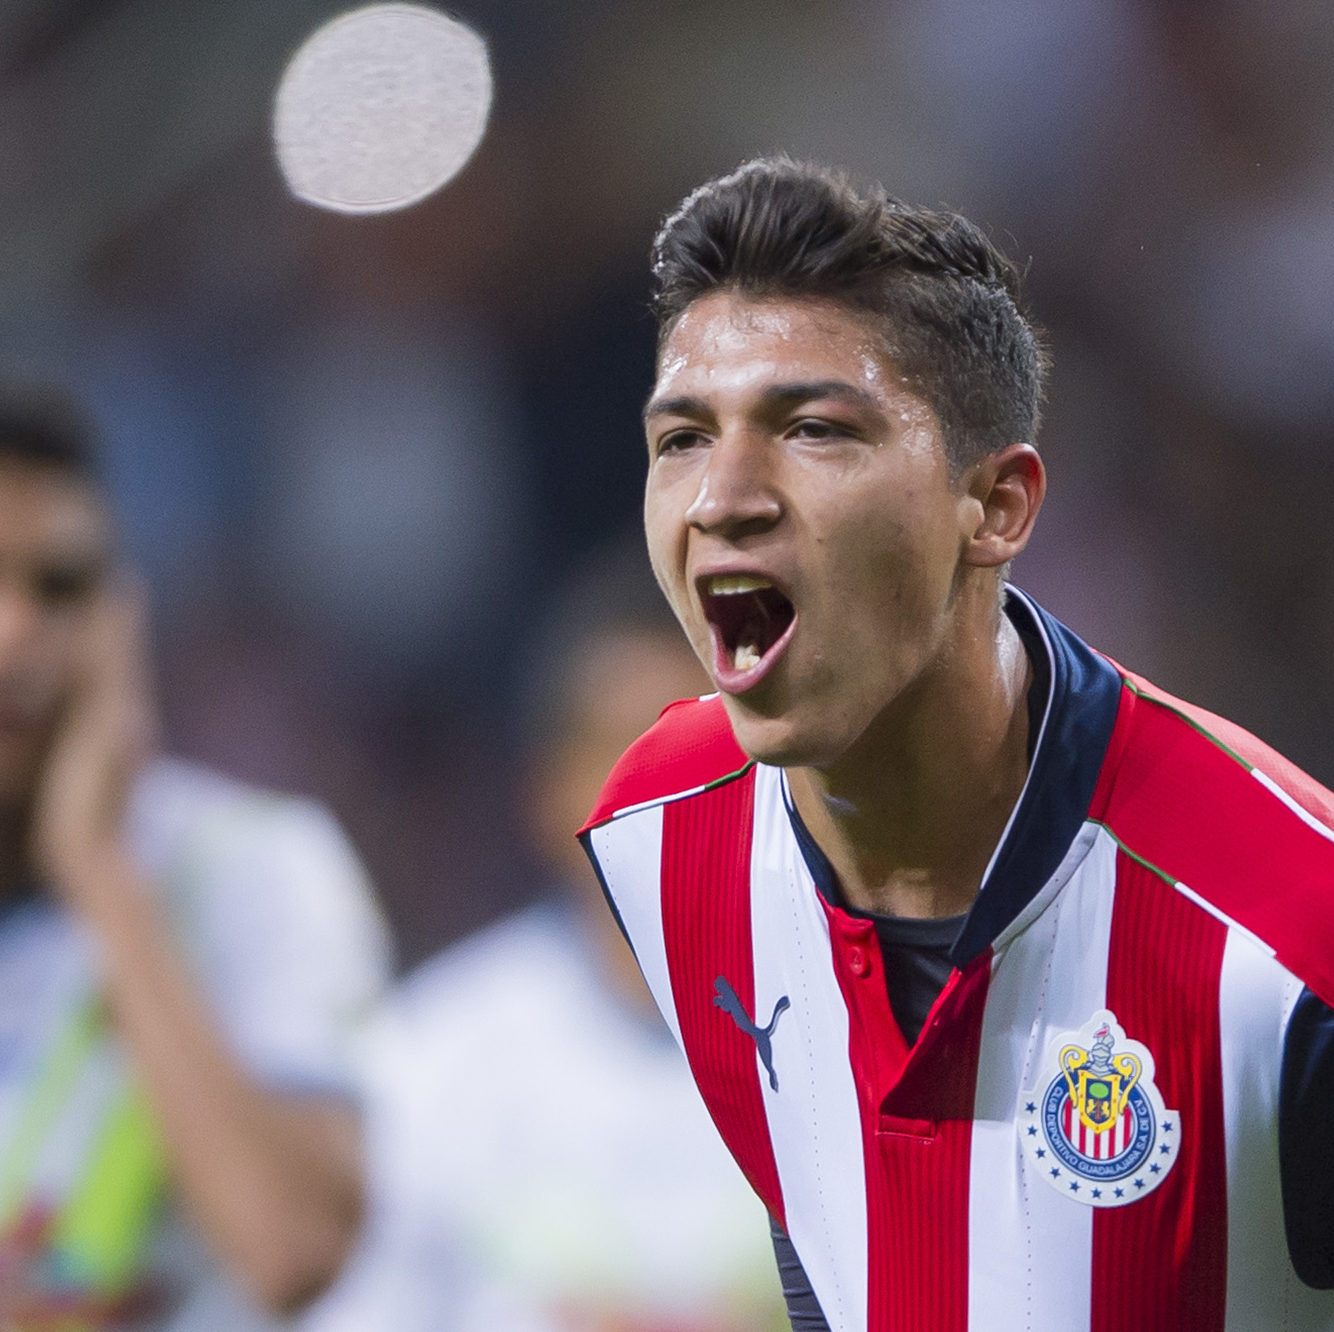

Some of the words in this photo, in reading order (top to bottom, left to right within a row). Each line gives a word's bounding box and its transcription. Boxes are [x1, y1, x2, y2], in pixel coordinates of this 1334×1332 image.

[1048, 1086, 1064, 1113] CLUB
[1047, 1114, 1078, 1165] DEPORTIVO
[1078, 1150, 1142, 1176] GUADALAJARA
